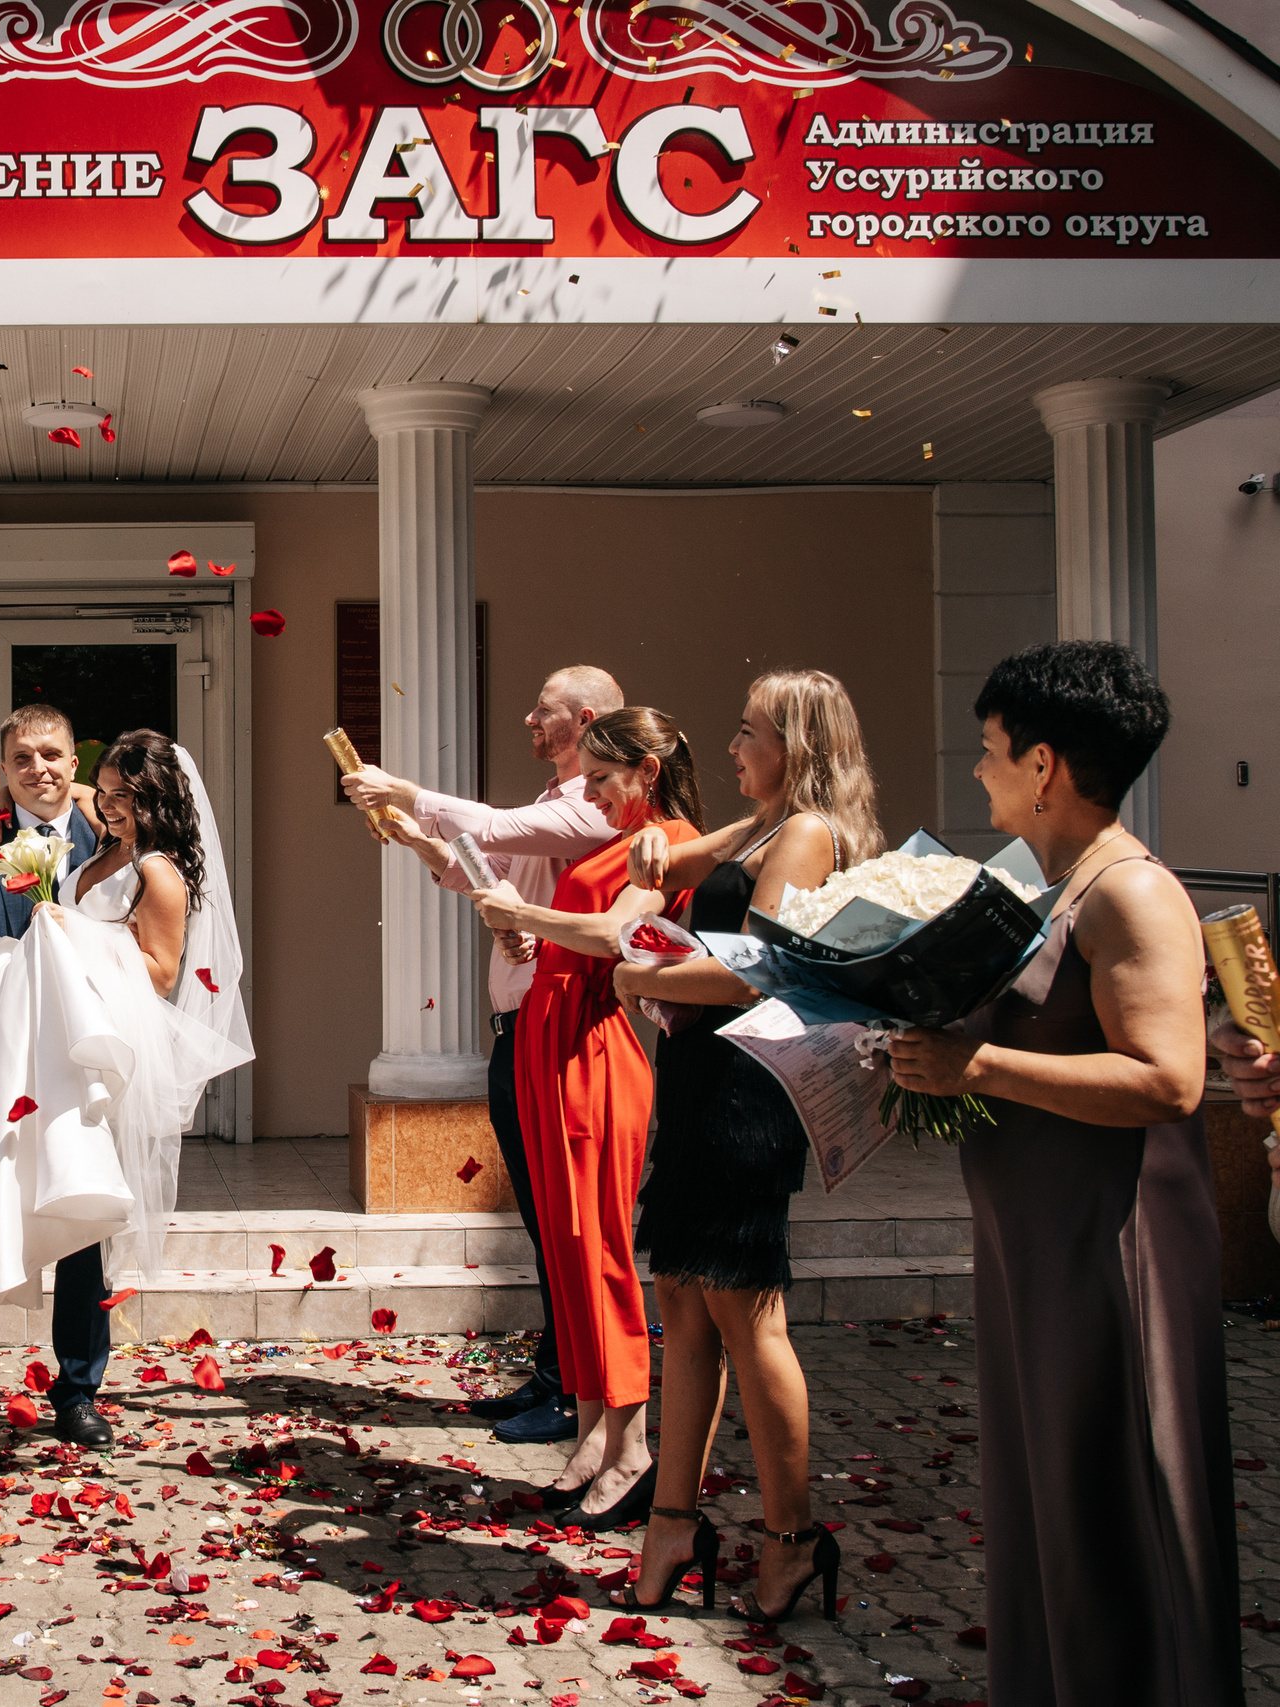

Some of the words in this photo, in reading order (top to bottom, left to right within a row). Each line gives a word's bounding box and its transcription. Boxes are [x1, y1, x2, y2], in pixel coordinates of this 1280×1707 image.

[804, 114, 1156, 153] Администрация
[184, 104, 763, 243] ЗАГС
[804, 158, 1104, 199] Уссурийского
[808, 213, 1051, 246] городского
[1064, 213, 1210, 246] округа
[985, 908, 1024, 947] ARRIVALS
[791, 936, 812, 951] BE
[822, 948, 839, 960] IN
